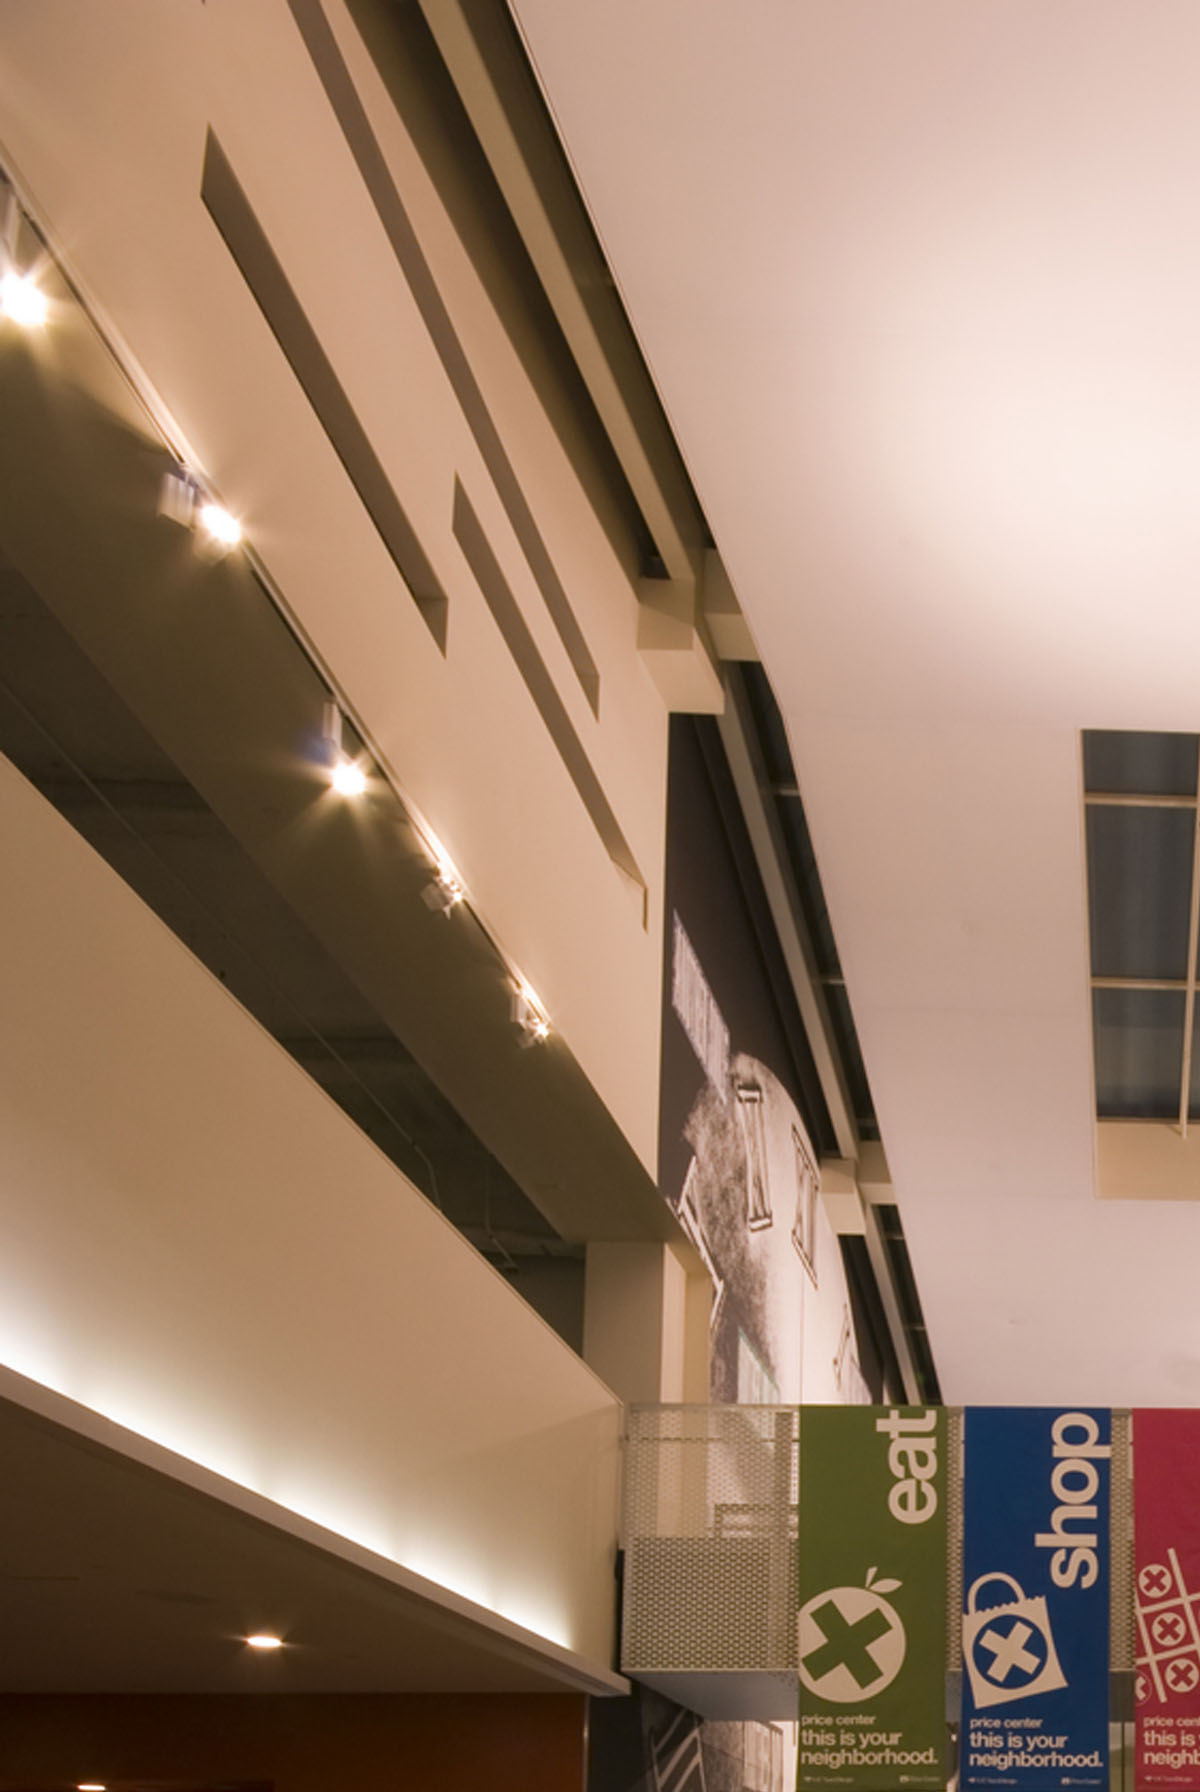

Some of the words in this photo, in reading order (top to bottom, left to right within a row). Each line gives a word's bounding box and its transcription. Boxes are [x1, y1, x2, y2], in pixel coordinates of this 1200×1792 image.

[876, 1410, 937, 1523] eat
[1035, 1413, 1110, 1588] shop
[802, 1715, 833, 1726] price
[836, 1715, 876, 1725] center
[970, 1718, 1001, 1729] price
[1004, 1718, 1043, 1728] center
[1144, 1717, 1173, 1727] price
[802, 1730, 836, 1745] this
[840, 1730, 856, 1745] is
[859, 1733, 902, 1747] your
[970, 1732, 1004, 1748] this
[1008, 1732, 1023, 1748] is
[1026, 1736, 1068, 1750] your
[1144, 1730, 1176, 1746] this
[1181, 1731, 1195, 1746] is
[801, 1748, 938, 1769] neighborhood.
[970, 1751, 1103, 1769] neighborhood.
